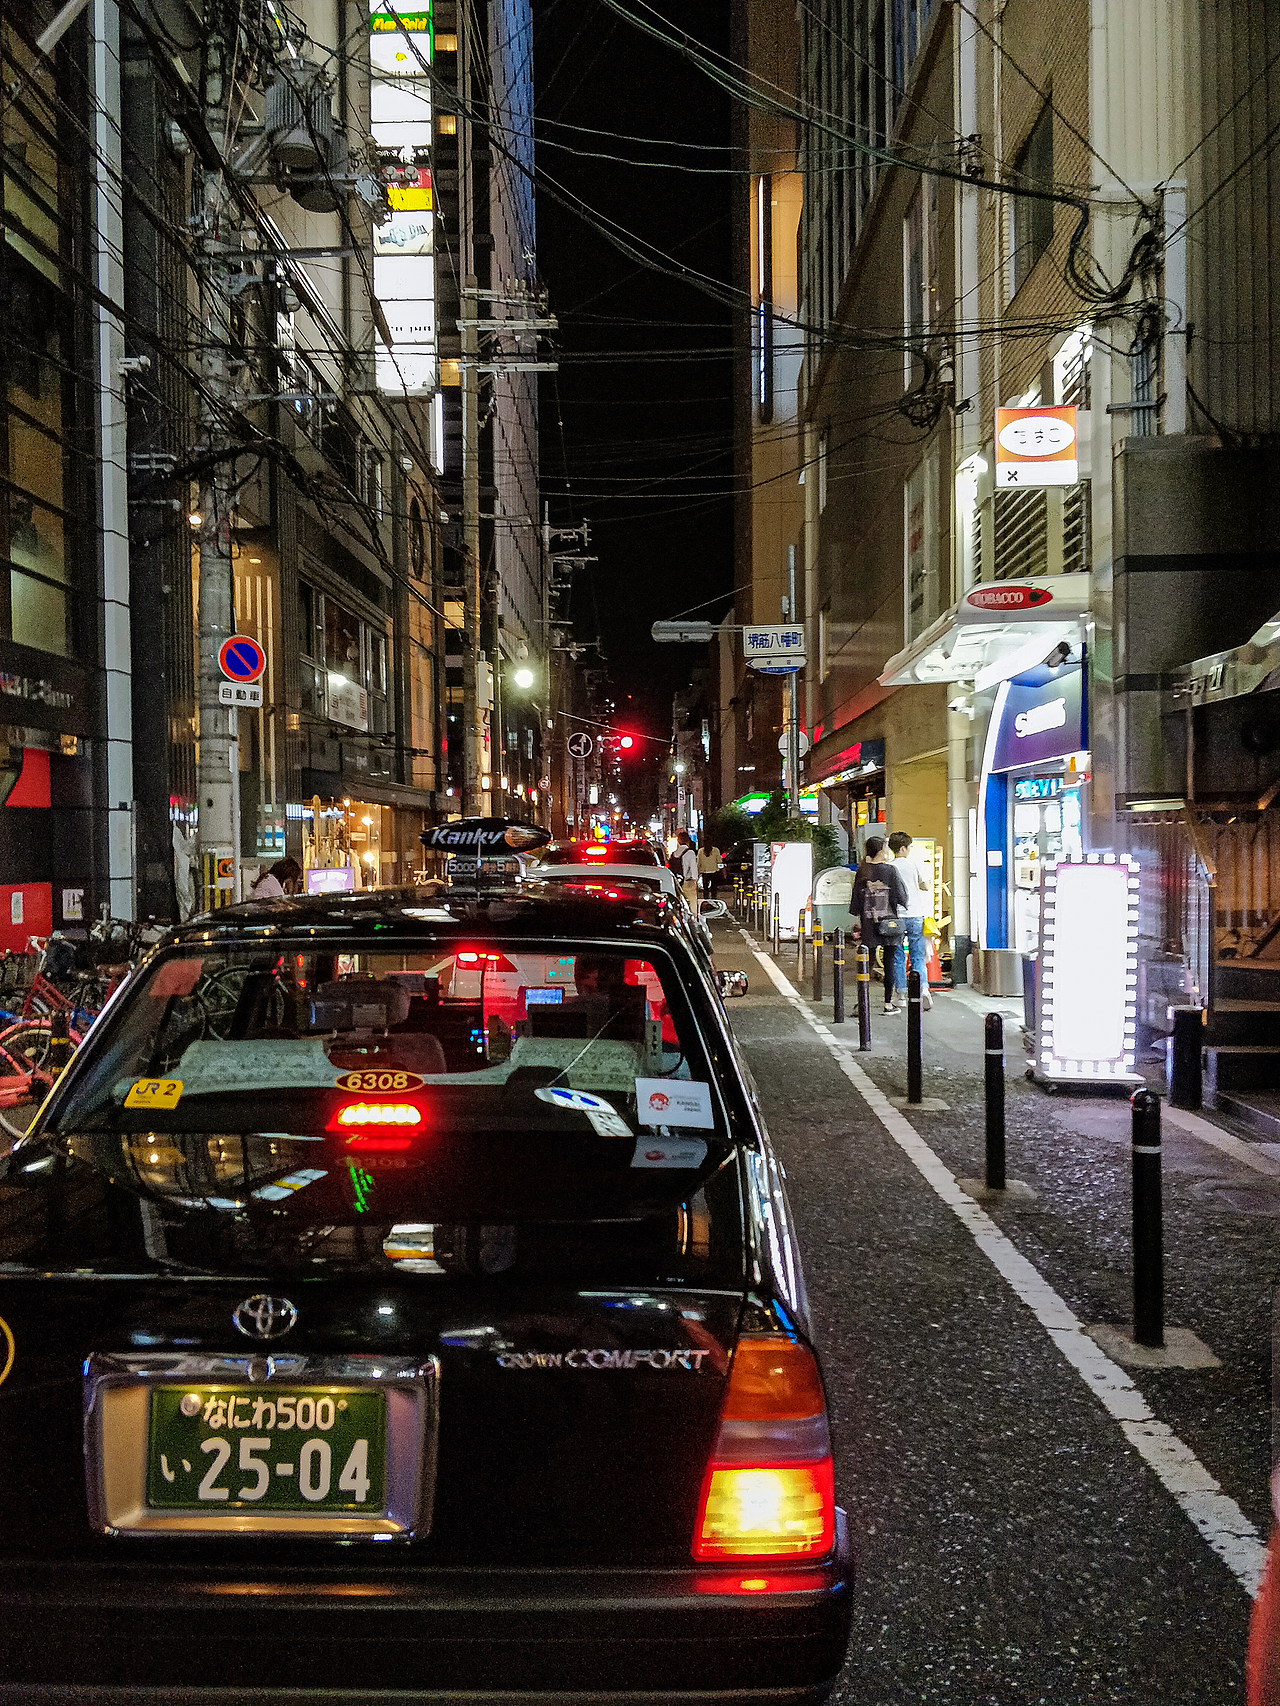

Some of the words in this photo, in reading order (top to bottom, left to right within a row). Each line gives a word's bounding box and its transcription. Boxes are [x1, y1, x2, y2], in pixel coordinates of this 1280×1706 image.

[966, 592, 1024, 605] TOBACCO
[747, 631, 803, 649] 堺筋八幡町
[222, 688, 260, 701] 自動車
[431, 827, 506, 845] Kanky
[135, 1082, 161, 1095] JR
[162, 1082, 177, 1096] 2
[346, 1073, 409, 1090] 6308
[496, 1351, 562, 1369] CROWN
[564, 1349, 710, 1369] COMFORT
[203, 1394, 336, 1431] なにわ500
[160, 1453, 192, 1483] い
[197, 1436, 371, 1502] 25-04
